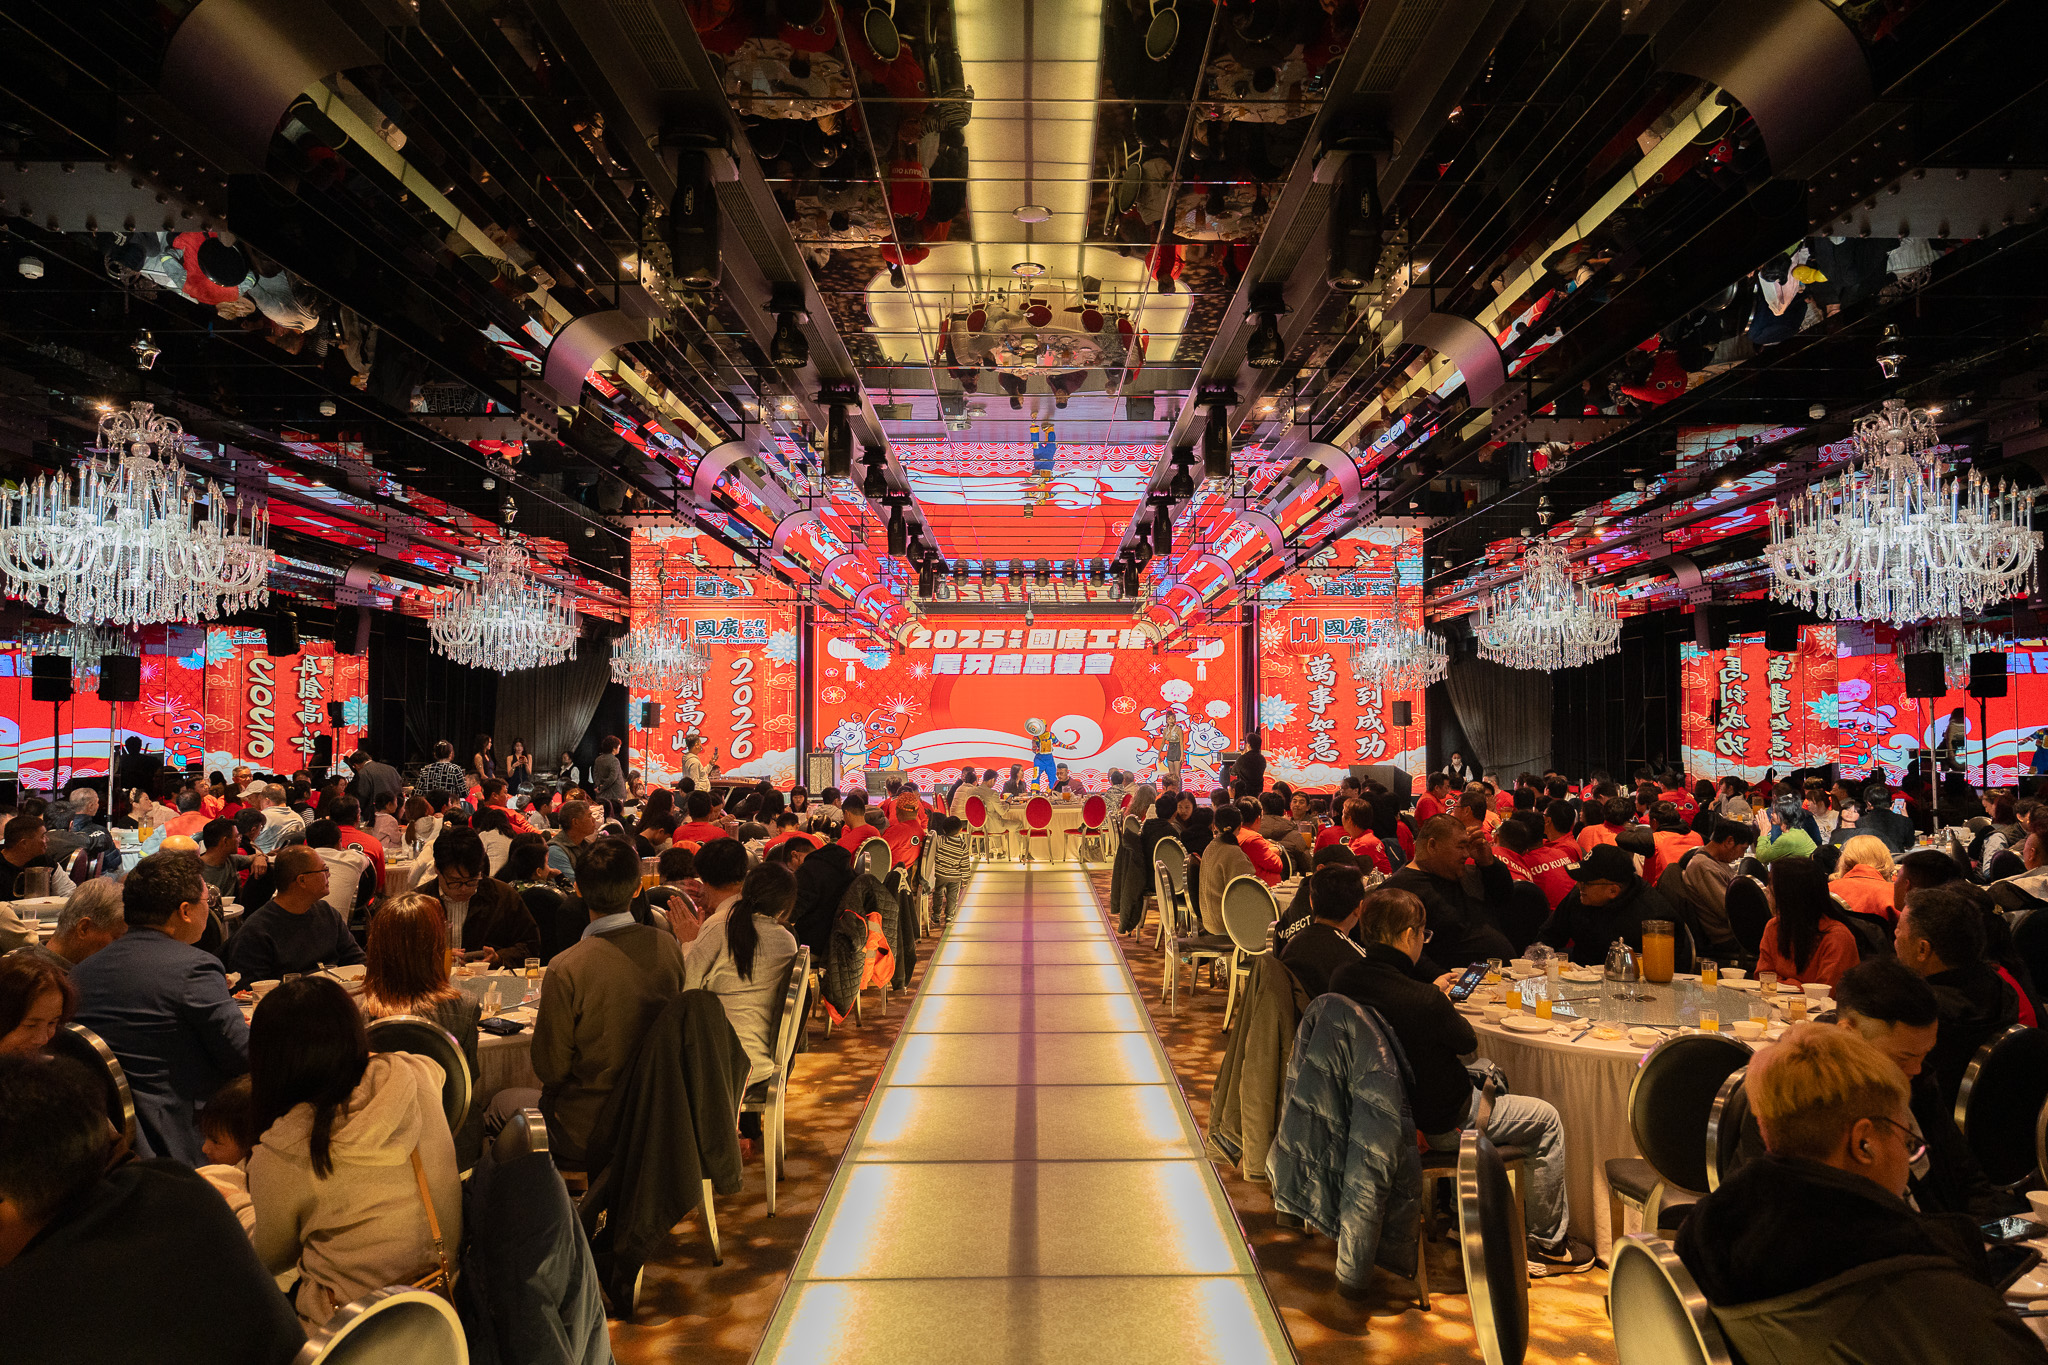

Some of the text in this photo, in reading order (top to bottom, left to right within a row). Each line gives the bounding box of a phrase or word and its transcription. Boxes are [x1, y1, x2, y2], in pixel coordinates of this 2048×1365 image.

[694, 617, 740, 638] 國廣
[1323, 617, 1368, 637] 國廣
[671, 673, 709, 754] 創高峰
[730, 657, 756, 760] 2026
[1305, 653, 1341, 763] 萬事如意
[1353, 674, 1387, 761] 到成功
